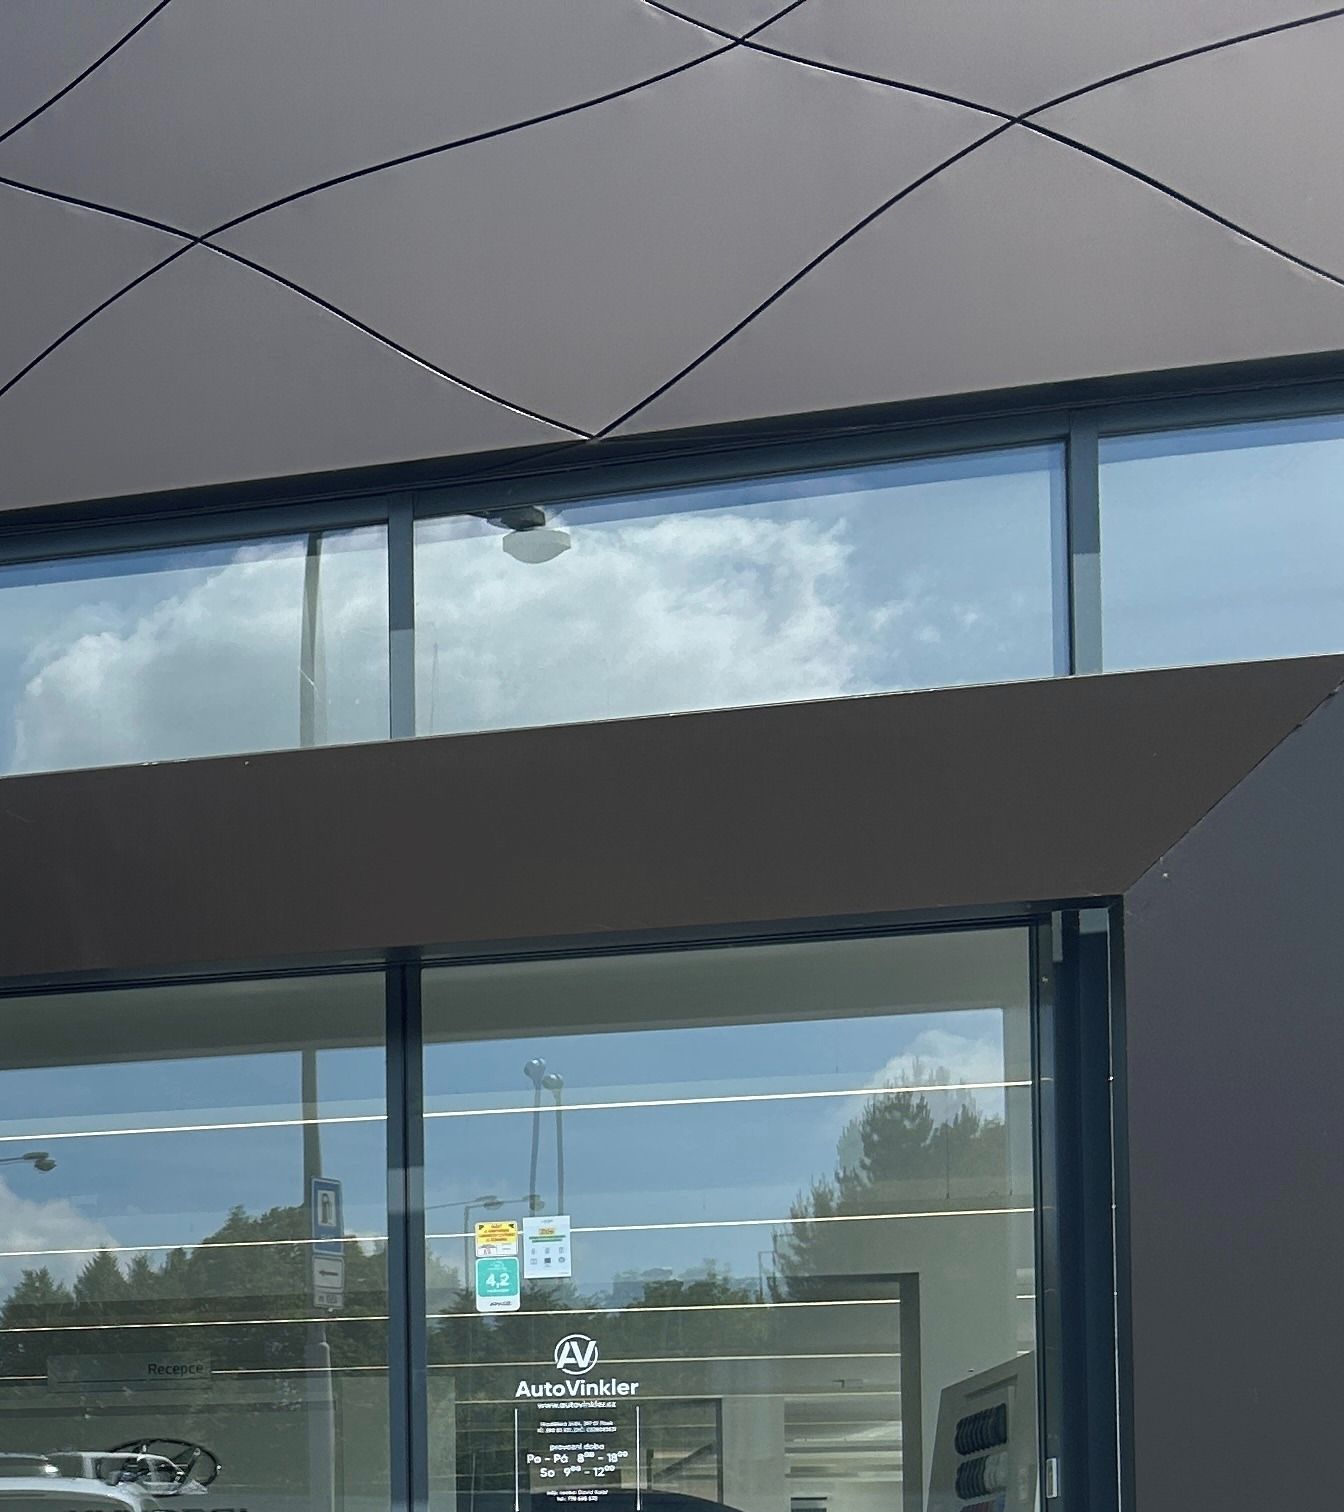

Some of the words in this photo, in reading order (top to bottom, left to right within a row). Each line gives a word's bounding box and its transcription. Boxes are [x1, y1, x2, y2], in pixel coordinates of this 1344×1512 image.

[148, 1363, 204, 1377] Recepce
[515, 1378, 640, 1398] AutoVinkler
[526, 1453, 542, 1464] Po
[553, 1453, 569, 1464] Pá
[540, 1467, 556, 1478] So
